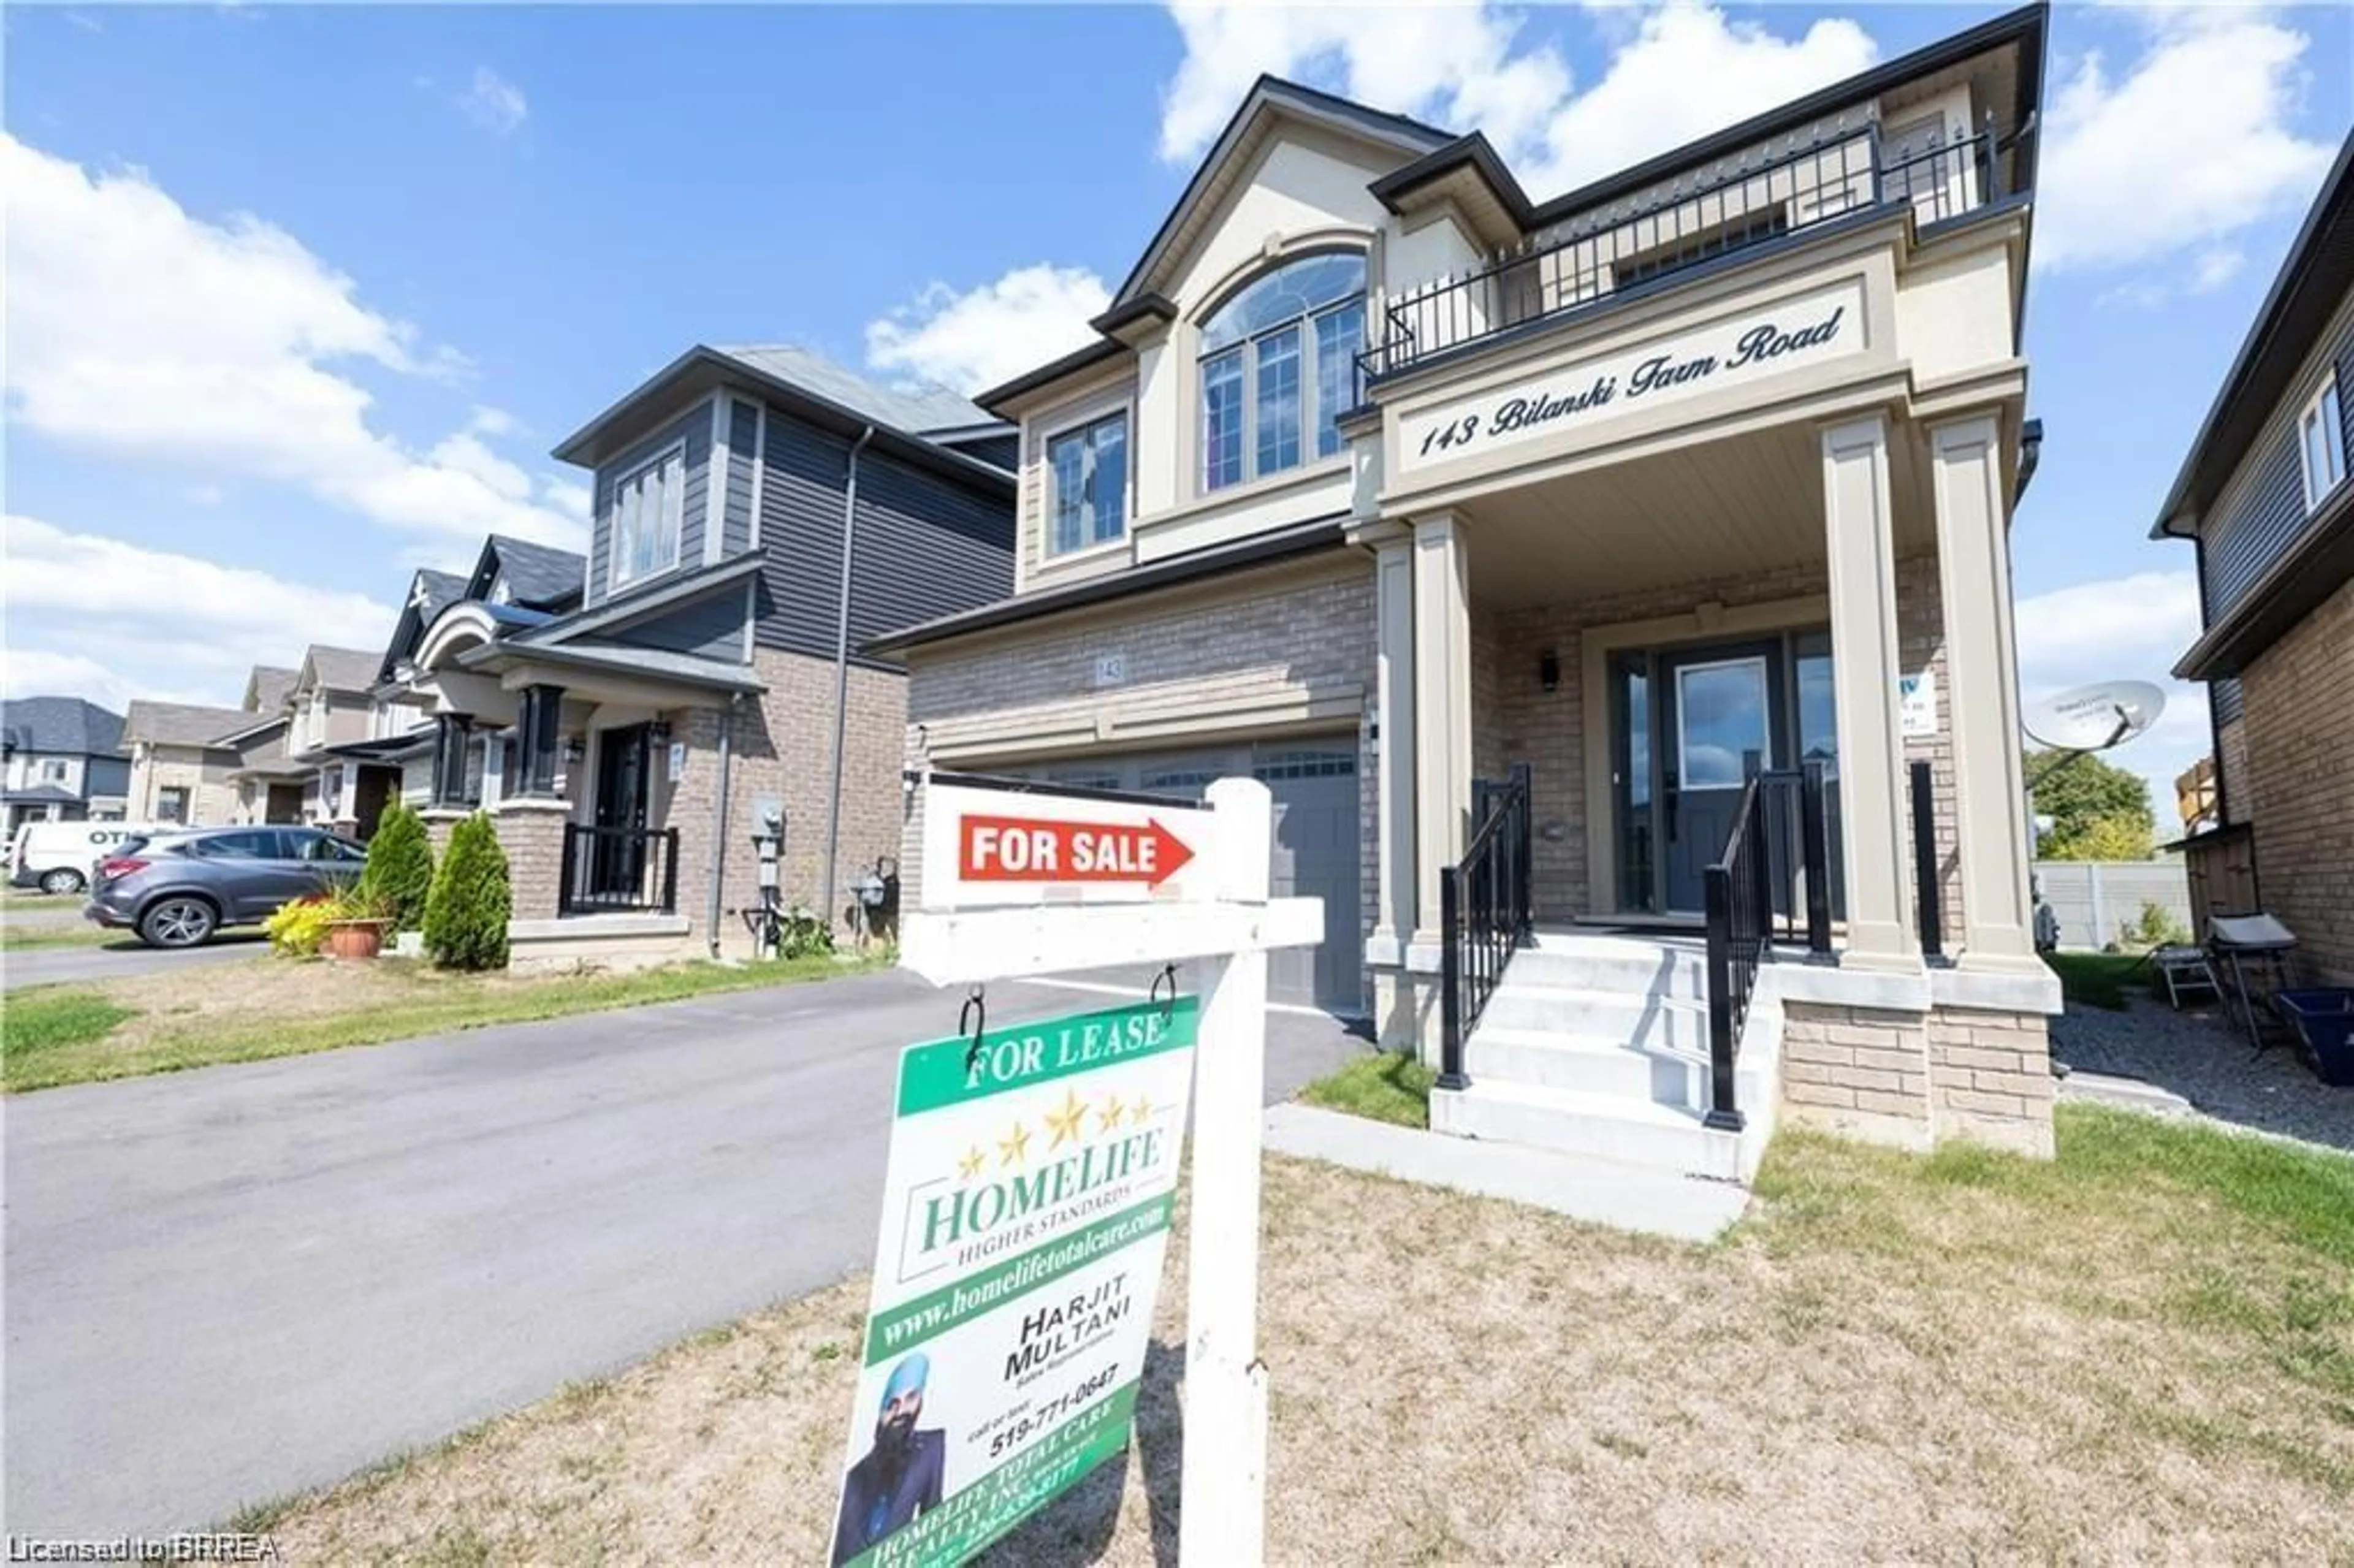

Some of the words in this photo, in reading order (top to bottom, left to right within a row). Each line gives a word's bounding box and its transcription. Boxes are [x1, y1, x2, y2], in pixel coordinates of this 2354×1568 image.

[1420, 415, 1479, 457] 143
[1488, 376, 1616, 436] Bilanski
[1626, 353, 1720, 397] Farm
[1725, 306, 1845, 370] Road
[972, 827, 1057, 871] FOR
[1072, 832, 1157, 872] SALE
[964, 1037, 1043, 1090] FOR
[1056, 1011, 1169, 1068] LEASE
[920, 1127, 1165, 1254] HOMELIFE
[956, 1220, 1035, 1267] HIGHER
[1039, 1185, 1132, 1233] STANDARDS
[883, 1205, 1165, 1346] www.homelifetotalcare.com
[1021, 1272, 1127, 1345] HARJIT
[1005, 1295, 1130, 1381] MULTANI
[989, 1362, 1119, 1458] 519-771-0647
[996, 1434, 1061, 1486] TOTAL
[1063, 1398, 1114, 1441] CARE
